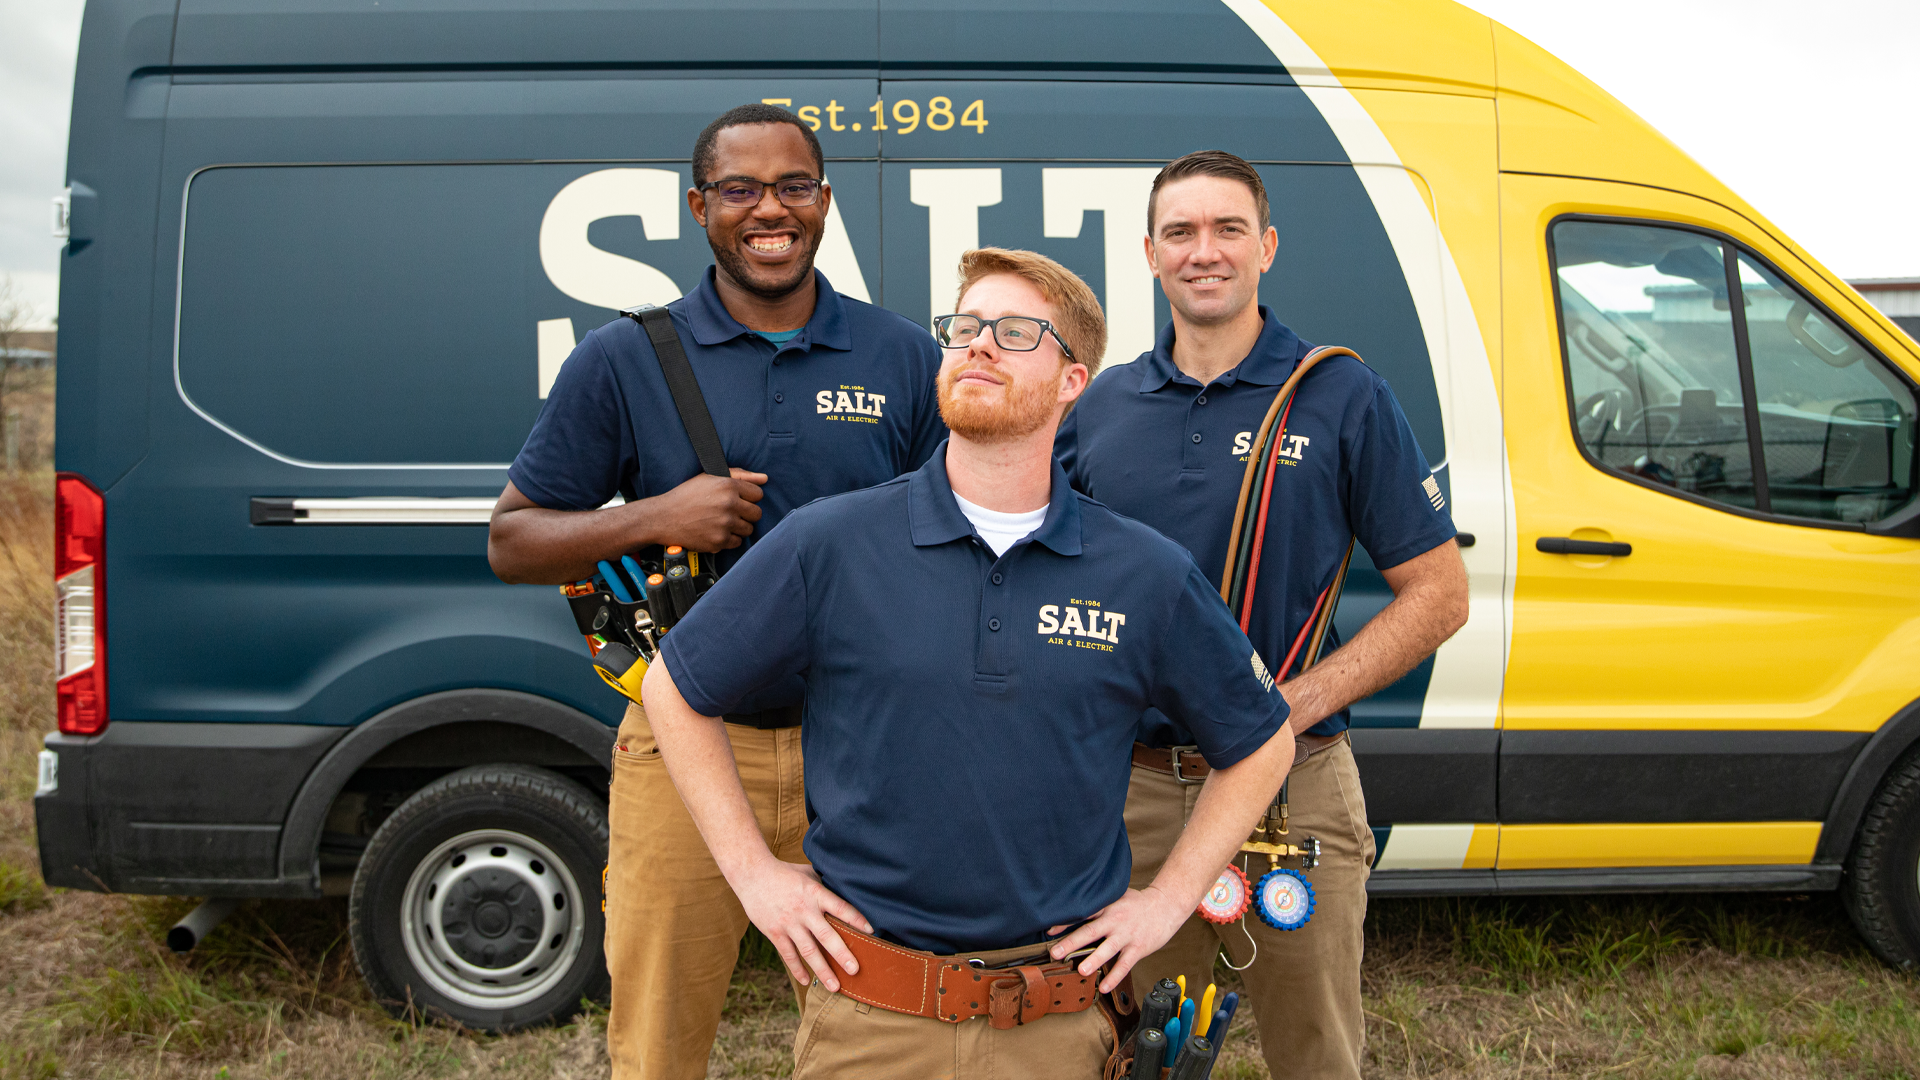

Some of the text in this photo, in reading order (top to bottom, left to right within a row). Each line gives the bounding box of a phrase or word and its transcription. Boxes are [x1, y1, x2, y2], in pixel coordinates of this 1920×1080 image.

[761, 96, 989, 135] st.1984
[537, 167, 1168, 400] ST
[816, 390, 886, 418] SALT
[847, 416, 879, 424] ELECTRIC
[1231, 431, 1310, 460] SLT
[1070, 598, 1101, 608] Est.1984
[1037, 604, 1126, 645] SALT
[1047, 637, 1114, 653] AIR & ELECTRIC
